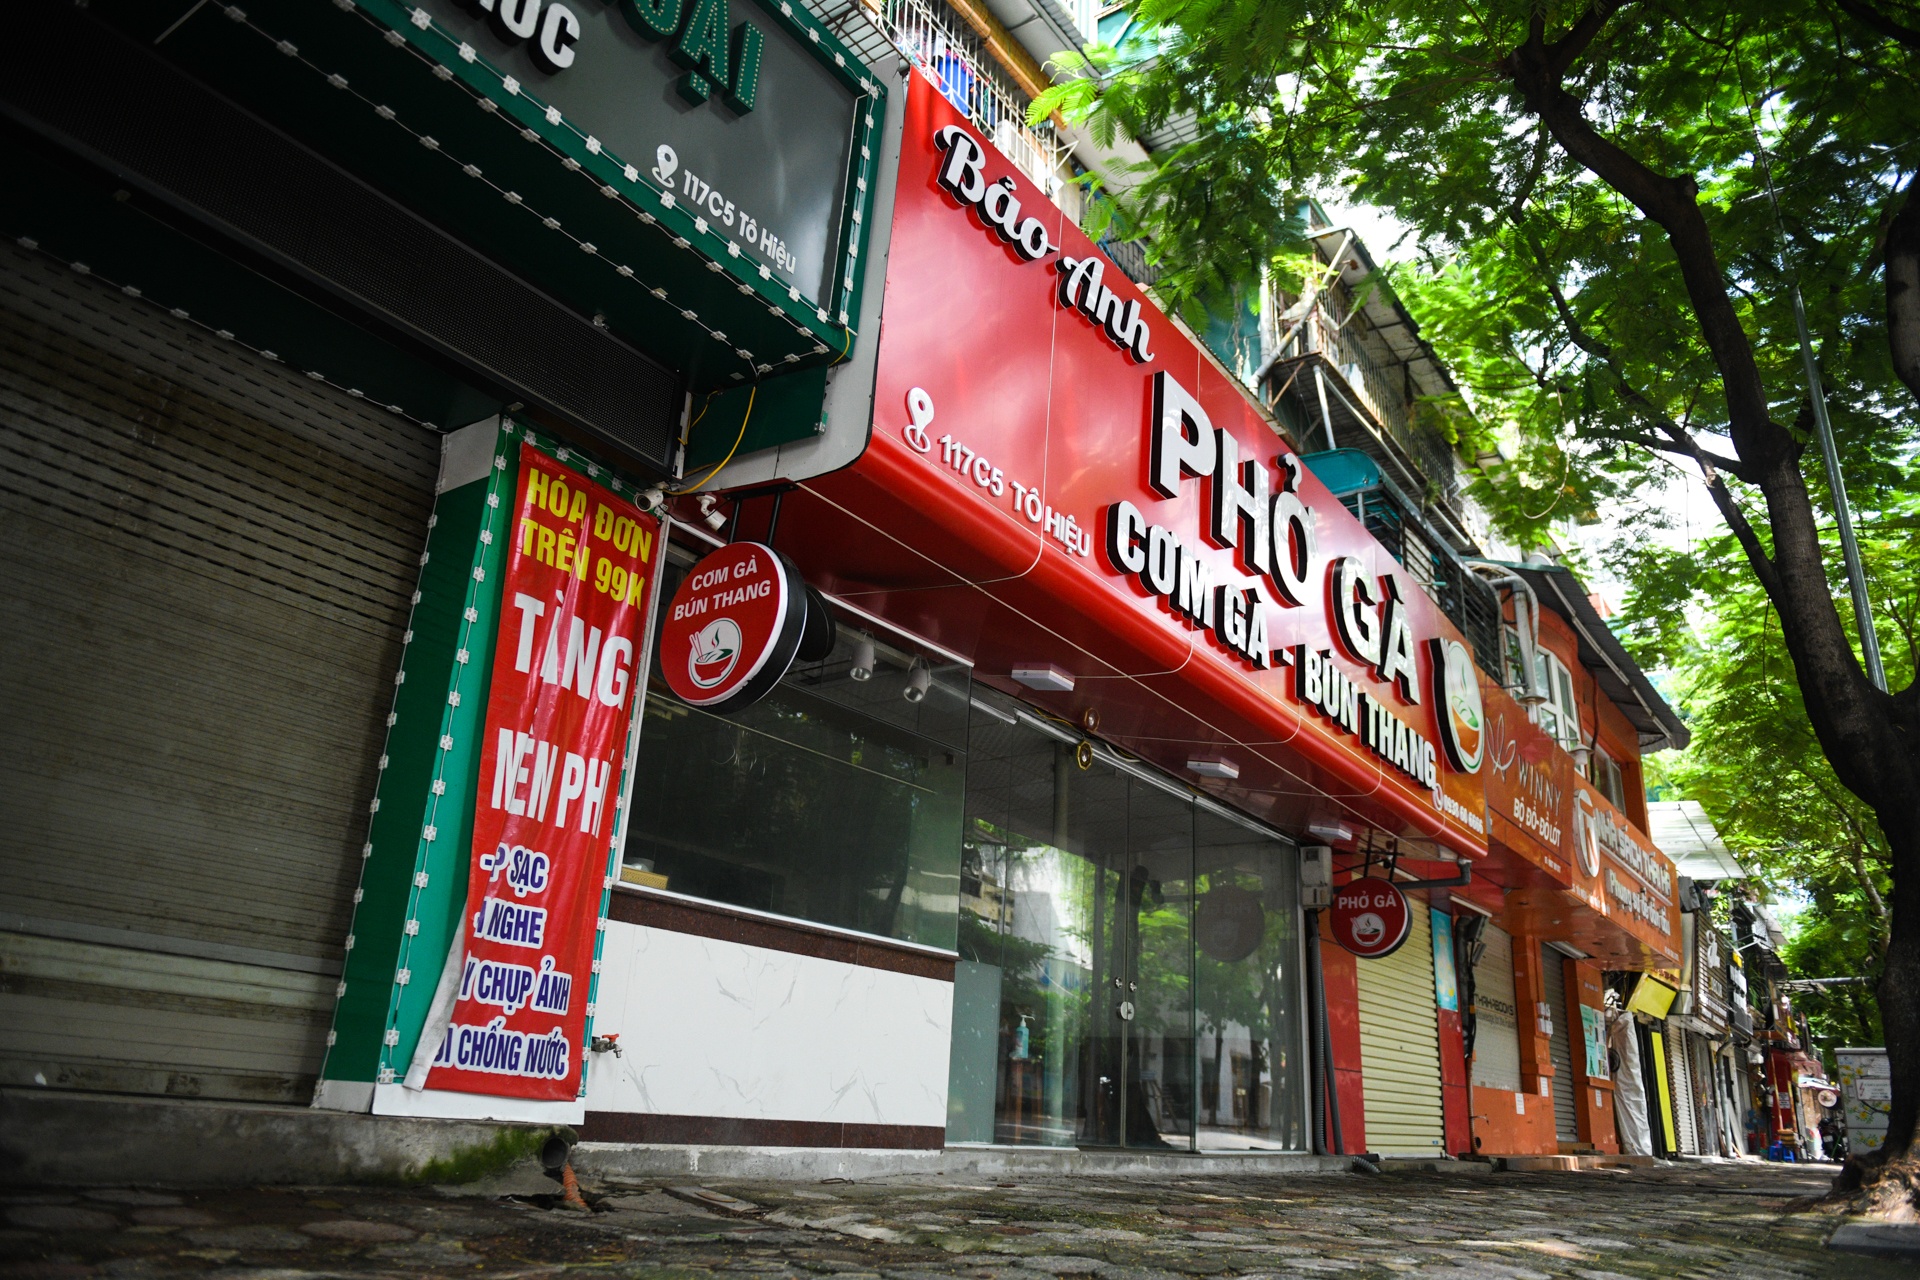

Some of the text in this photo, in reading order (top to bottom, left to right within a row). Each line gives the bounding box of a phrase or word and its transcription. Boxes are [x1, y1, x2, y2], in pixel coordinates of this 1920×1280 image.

[683, 170, 797, 275] 117C5 Tô Hiệu
[934, 125, 1155, 363] Bảo Anh
[527, 467, 652, 564] HÓA ĐƠN
[940, 434, 1090, 557] 117C5 TÔ HIỆU
[521, 518, 645, 611] TRÊN 99K
[1150, 370, 1420, 705] PHỞ GÀ
[674, 580, 771, 621] BÚN THANG
[691, 554, 758, 591] CƠM GÀ
[1107, 501, 1214, 630] CƠM
[1215, 584, 1270, 670] GÀ
[1296, 644, 1358, 735] BÚN
[1358, 693, 1437, 790] THANG
[1518, 754, 1562, 817] WINNY
[510, 850, 546, 893] SẠC
[1338, 891, 1397, 909] PHỞ GÀ
[487, 903, 543, 945] NGHE
[478, 964, 532, 1010] CHỤP
[535, 960, 570, 1011] ẢNH
[458, 1020, 522, 1070] CHỐNG
[524, 1031, 568, 1075] NƯỚC
